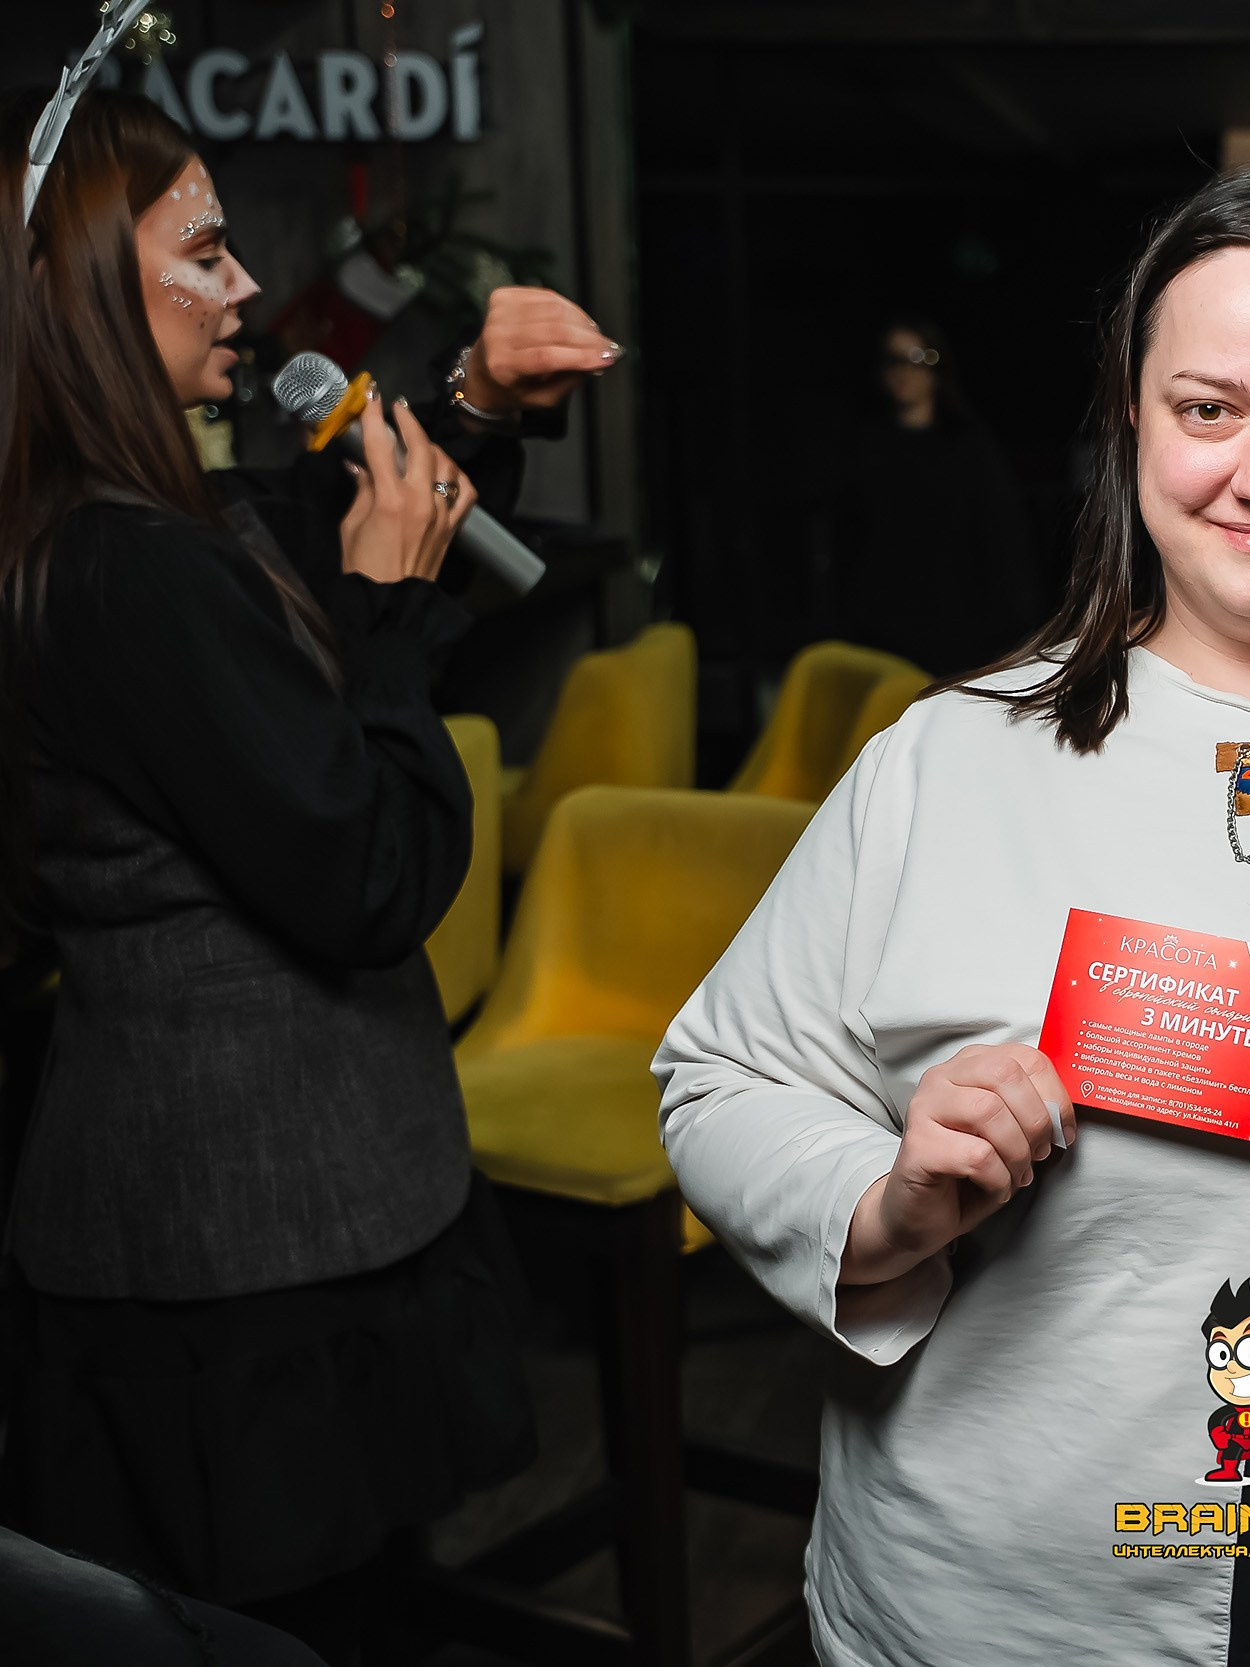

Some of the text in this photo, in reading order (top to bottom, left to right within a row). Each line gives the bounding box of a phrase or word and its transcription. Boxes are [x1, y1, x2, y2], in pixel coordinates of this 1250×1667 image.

[1120, 935, 1218, 971] КРАСОТА
[1088, 961, 1240, 1007] СЕРТИФИКАТ
[1099, 977, 1115, 993] в
[1140, 1007, 1156, 1027] 3
[1085, 1030, 1202, 1062] большой ассортимент кремов
[1087, 1021, 1210, 1052] самые мощные лампы в городе
[1080, 1053, 1147, 1073] виброплатформа
[1147, 1067, 1153, 1075] в
[1153, 1068, 1181, 1081] пакете
[1082, 1042, 1212, 1075] наборы индивидуальной защиты
[1077, 1064, 1114, 1078] контроль
[1114, 1072, 1133, 1082] веса
[1140, 1077, 1160, 1088] вода
[1160, 1081, 1166, 1089] с
[1165, 1082, 1203, 1096] лимоном
[1097, 1085, 1127, 1097] телефон
[1125, 1092, 1141, 1100] для
[1095, 1093, 1107, 1101] мы
[1107, 1096, 1146, 1109] находимся
[1145, 1104, 1156, 1112] по
[1223, 1120, 1240, 1130] 41/1
